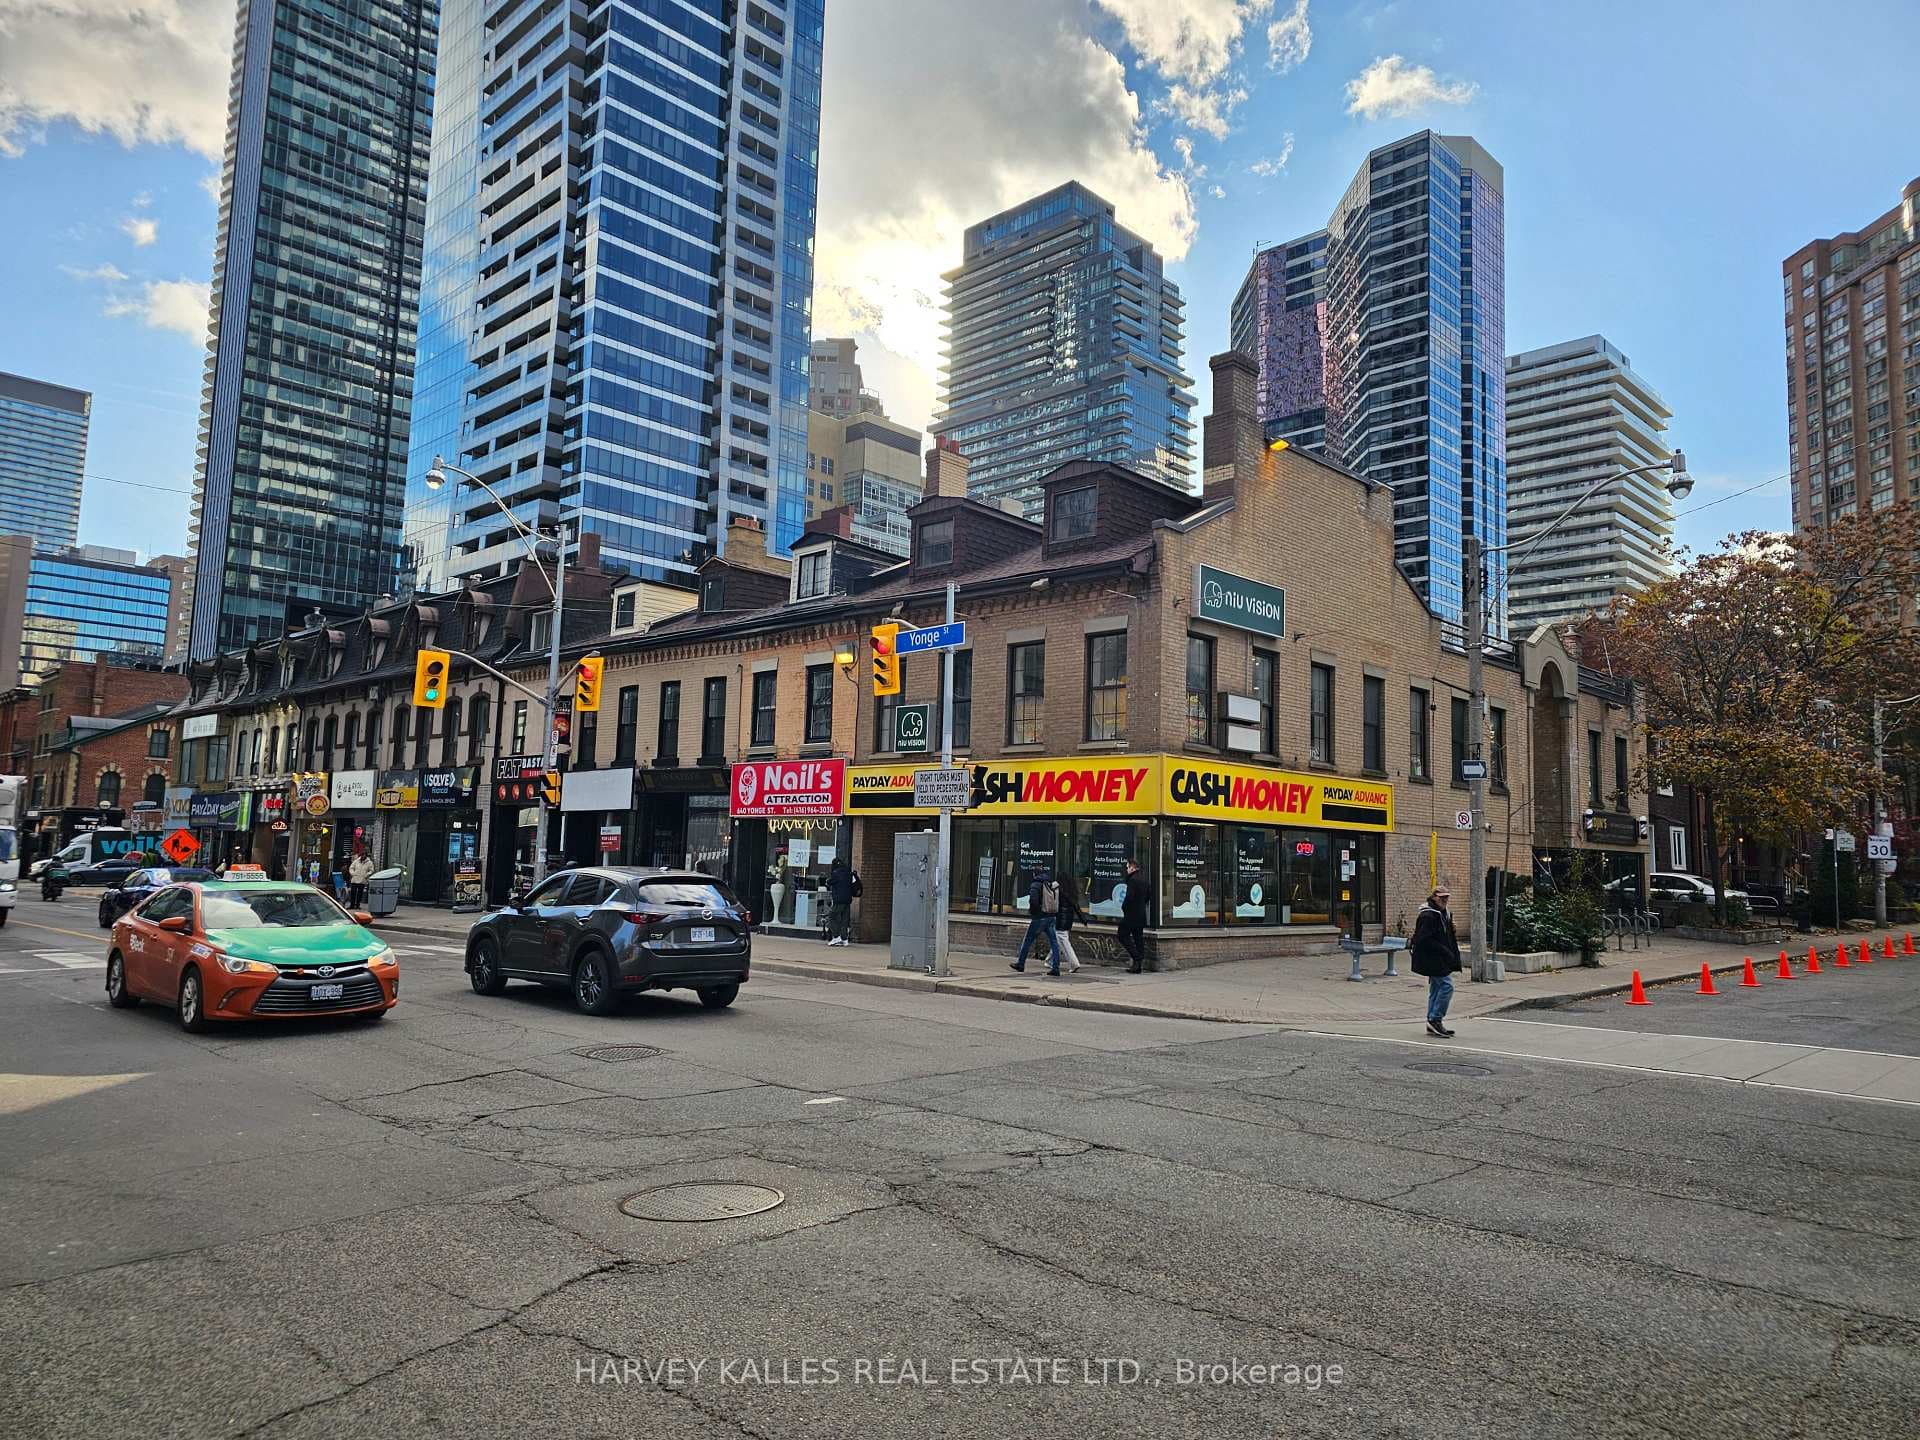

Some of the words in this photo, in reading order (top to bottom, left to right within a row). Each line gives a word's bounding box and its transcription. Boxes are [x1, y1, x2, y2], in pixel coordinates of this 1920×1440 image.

[910, 631, 940, 647] Yonge
[496, 759, 521, 779] FAT
[764, 764, 832, 791] Nail's
[853, 776, 891, 788] PAYDAY
[891, 776, 914, 788] ADV
[920, 772, 933, 782] RIGHT
[934, 772, 950, 782] TURNS
[951, 772, 964, 781] MUST
[916, 785, 928, 793] YIELD
[929, 785, 936, 793] TO
[936, 783, 969, 793] PEDESTRIANS
[766, 794, 829, 804] ATTRACTION
[918, 795, 940, 804] CROSSING
[941, 795, 957, 804] YONGE
[1323, 786, 1354, 801] PAYDAY
[1354, 790, 1388, 806] ADVANCE
[747, 807, 765, 815] YONGE
[1296, 842, 1314, 854] OPEN
[1870, 845, 1889, 856] 30
